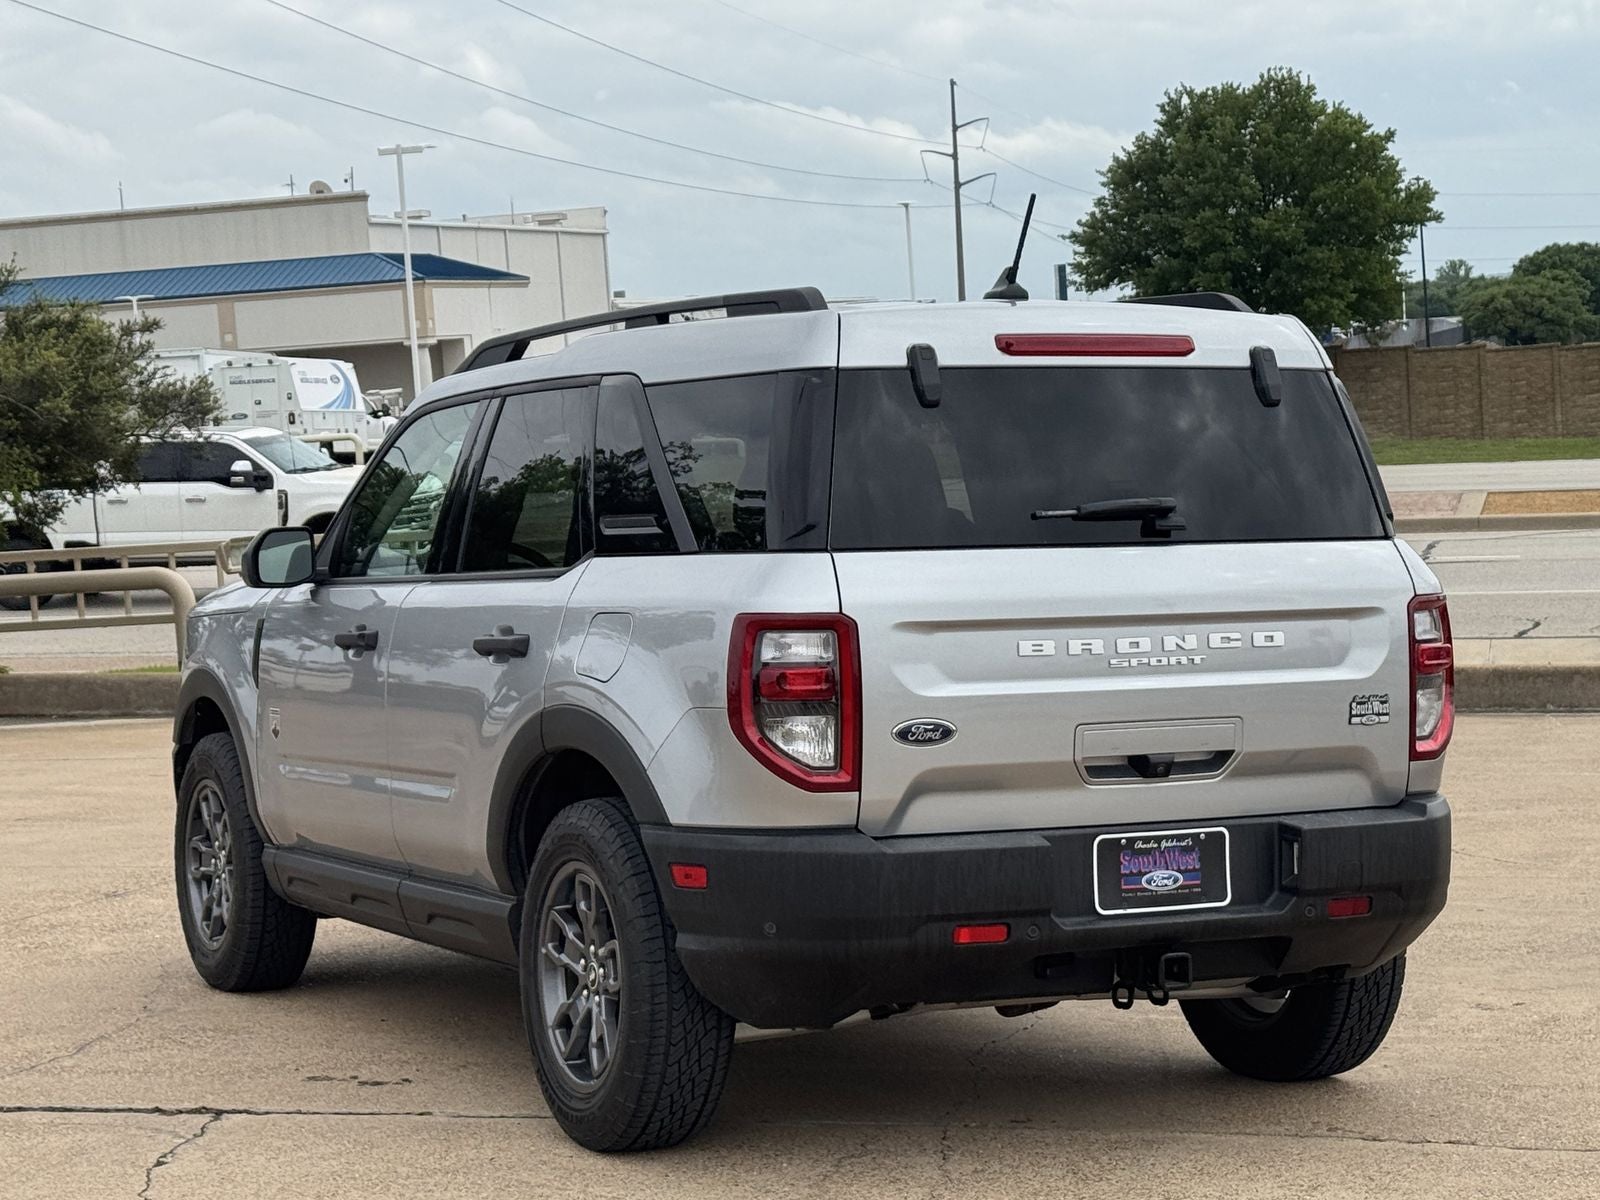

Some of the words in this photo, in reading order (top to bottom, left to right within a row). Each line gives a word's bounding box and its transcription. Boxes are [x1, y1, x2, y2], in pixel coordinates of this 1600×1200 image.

[1018, 631, 1285, 656] BRONCO
[1108, 655, 1206, 668] SPORT
[908, 724, 943, 741] Ford
[1151, 873, 1175, 887] Ford
